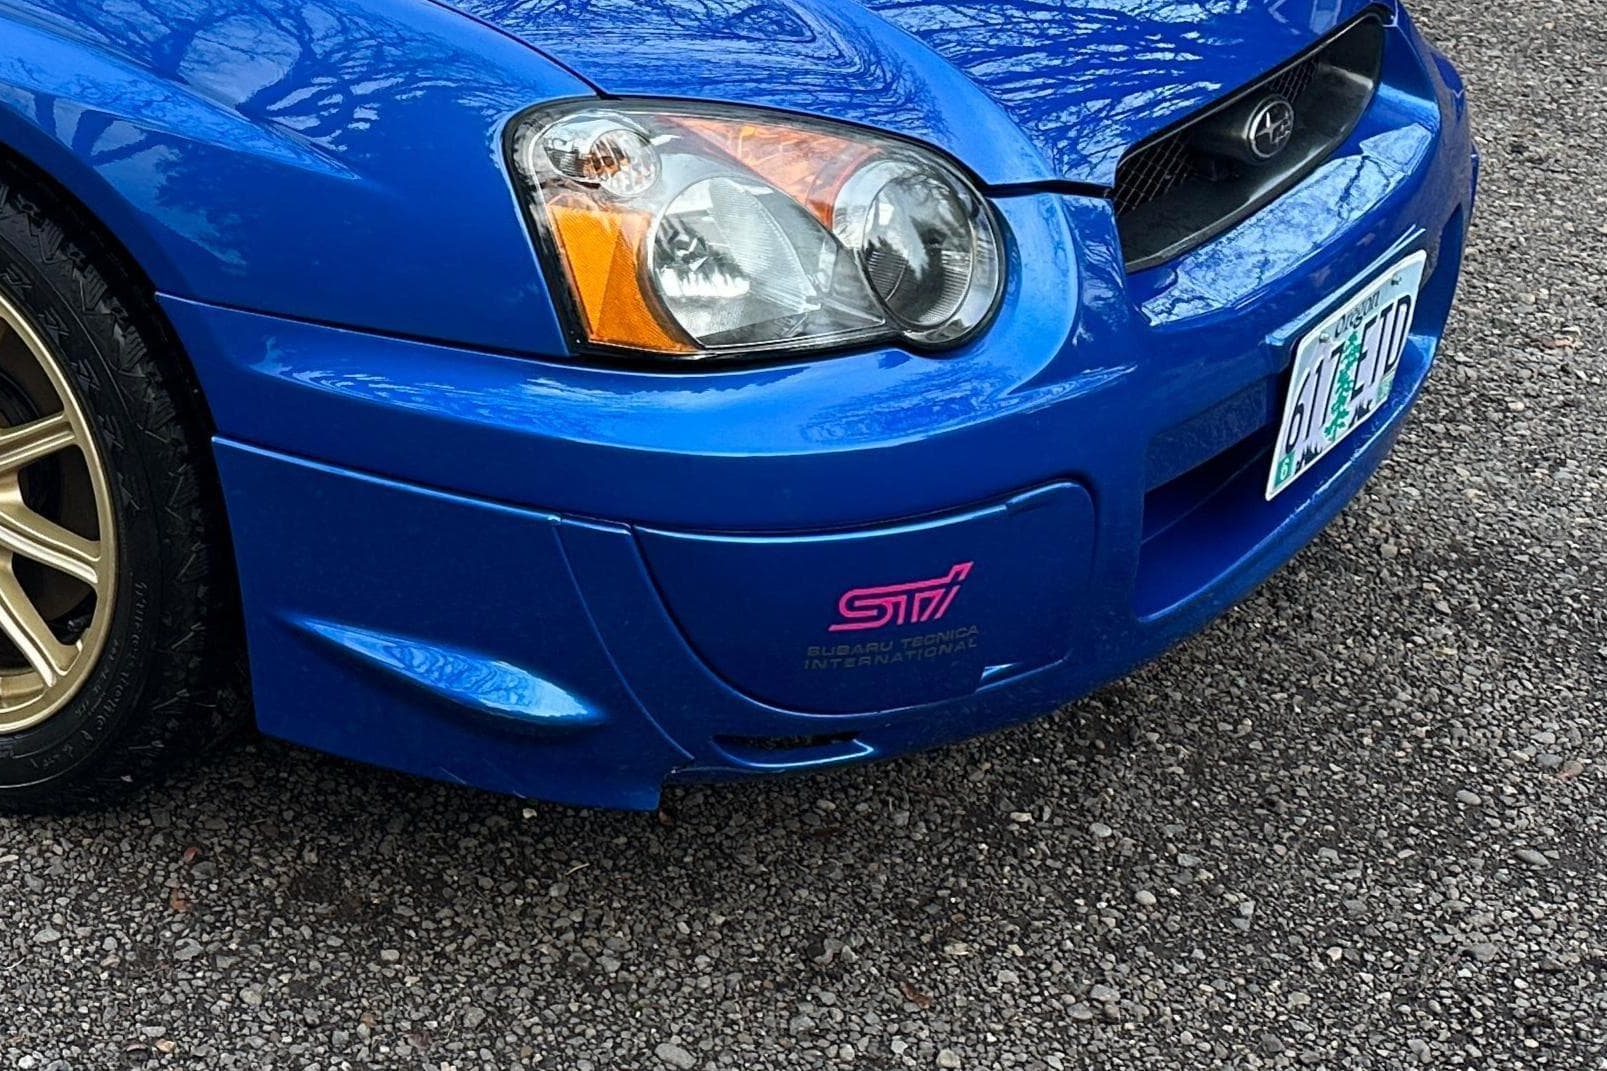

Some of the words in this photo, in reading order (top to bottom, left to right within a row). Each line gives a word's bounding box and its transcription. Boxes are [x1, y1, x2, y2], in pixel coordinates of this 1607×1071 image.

[1334, 291, 1380, 339] Oregon
[1285, 340, 1346, 455] 617
[1350, 294, 1411, 402] ETD
[803, 636, 978, 671] INTERNATIONAL
[806, 641, 894, 658] SUBARU
[900, 624, 980, 650] TECNICA
